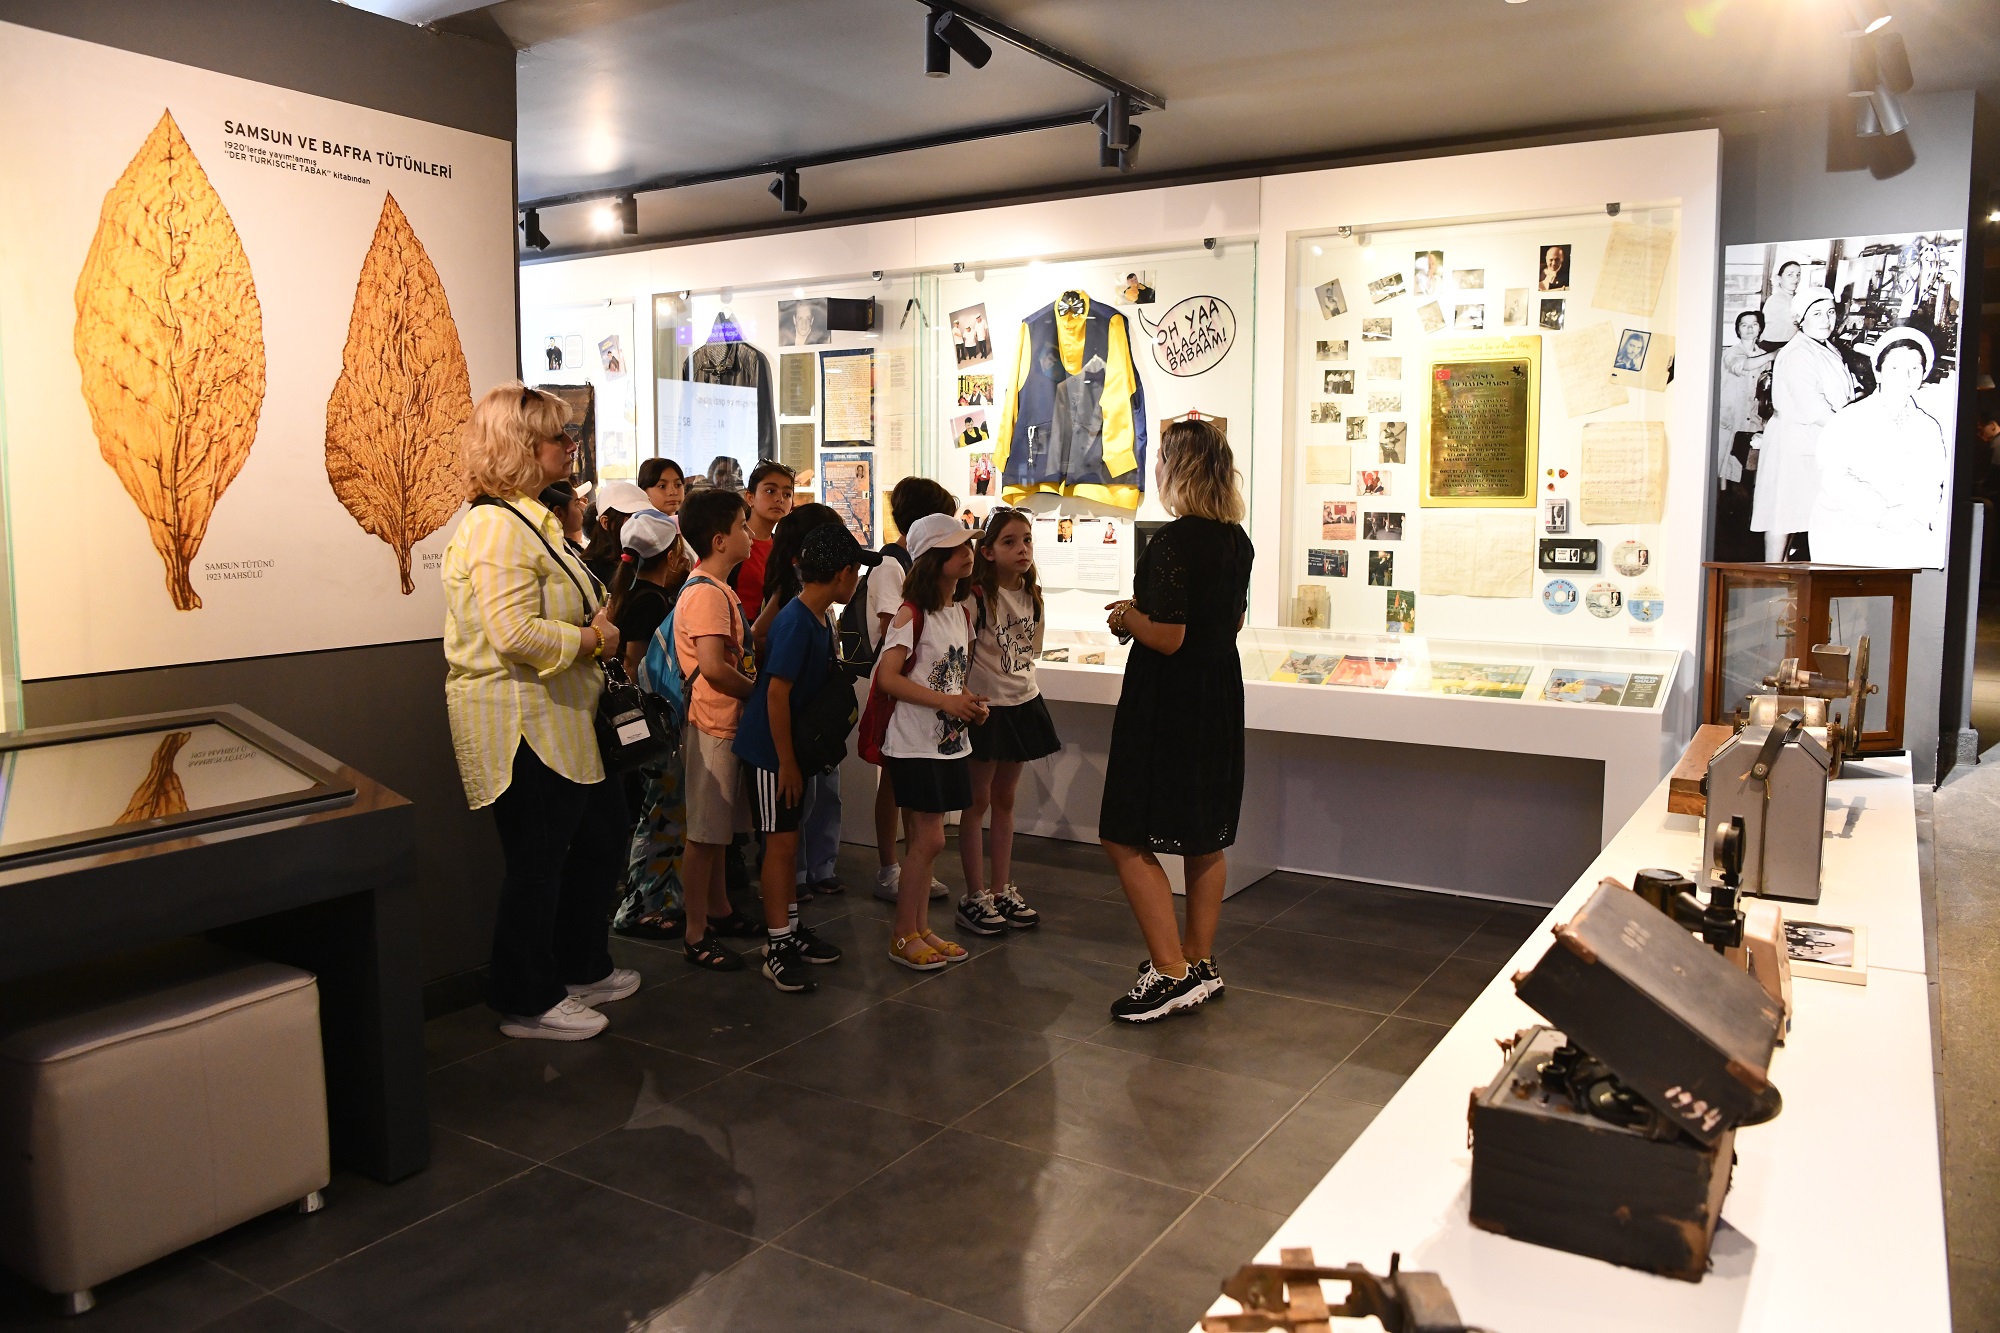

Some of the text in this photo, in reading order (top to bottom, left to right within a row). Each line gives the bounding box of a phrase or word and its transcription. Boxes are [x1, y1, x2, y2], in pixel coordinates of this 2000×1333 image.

[224, 120, 452, 179] SAMSUN VE BAFRA TÜTÜNLERİ
[268, 151, 317, 167] yayımlanmış
[249, 155, 297, 171] TURKISCHE
[333, 171, 371, 185] kitabından
[1156, 299, 1219, 346] OH YAA
[1166, 321, 1216, 360] ALACAK
[1169, 327, 1227, 371] BABAAM!
[205, 559, 275, 571] SAMSUN TÜTÜNÜ
[206, 573, 221, 581] 1923
[1664, 1085, 1723, 1132] 1994
